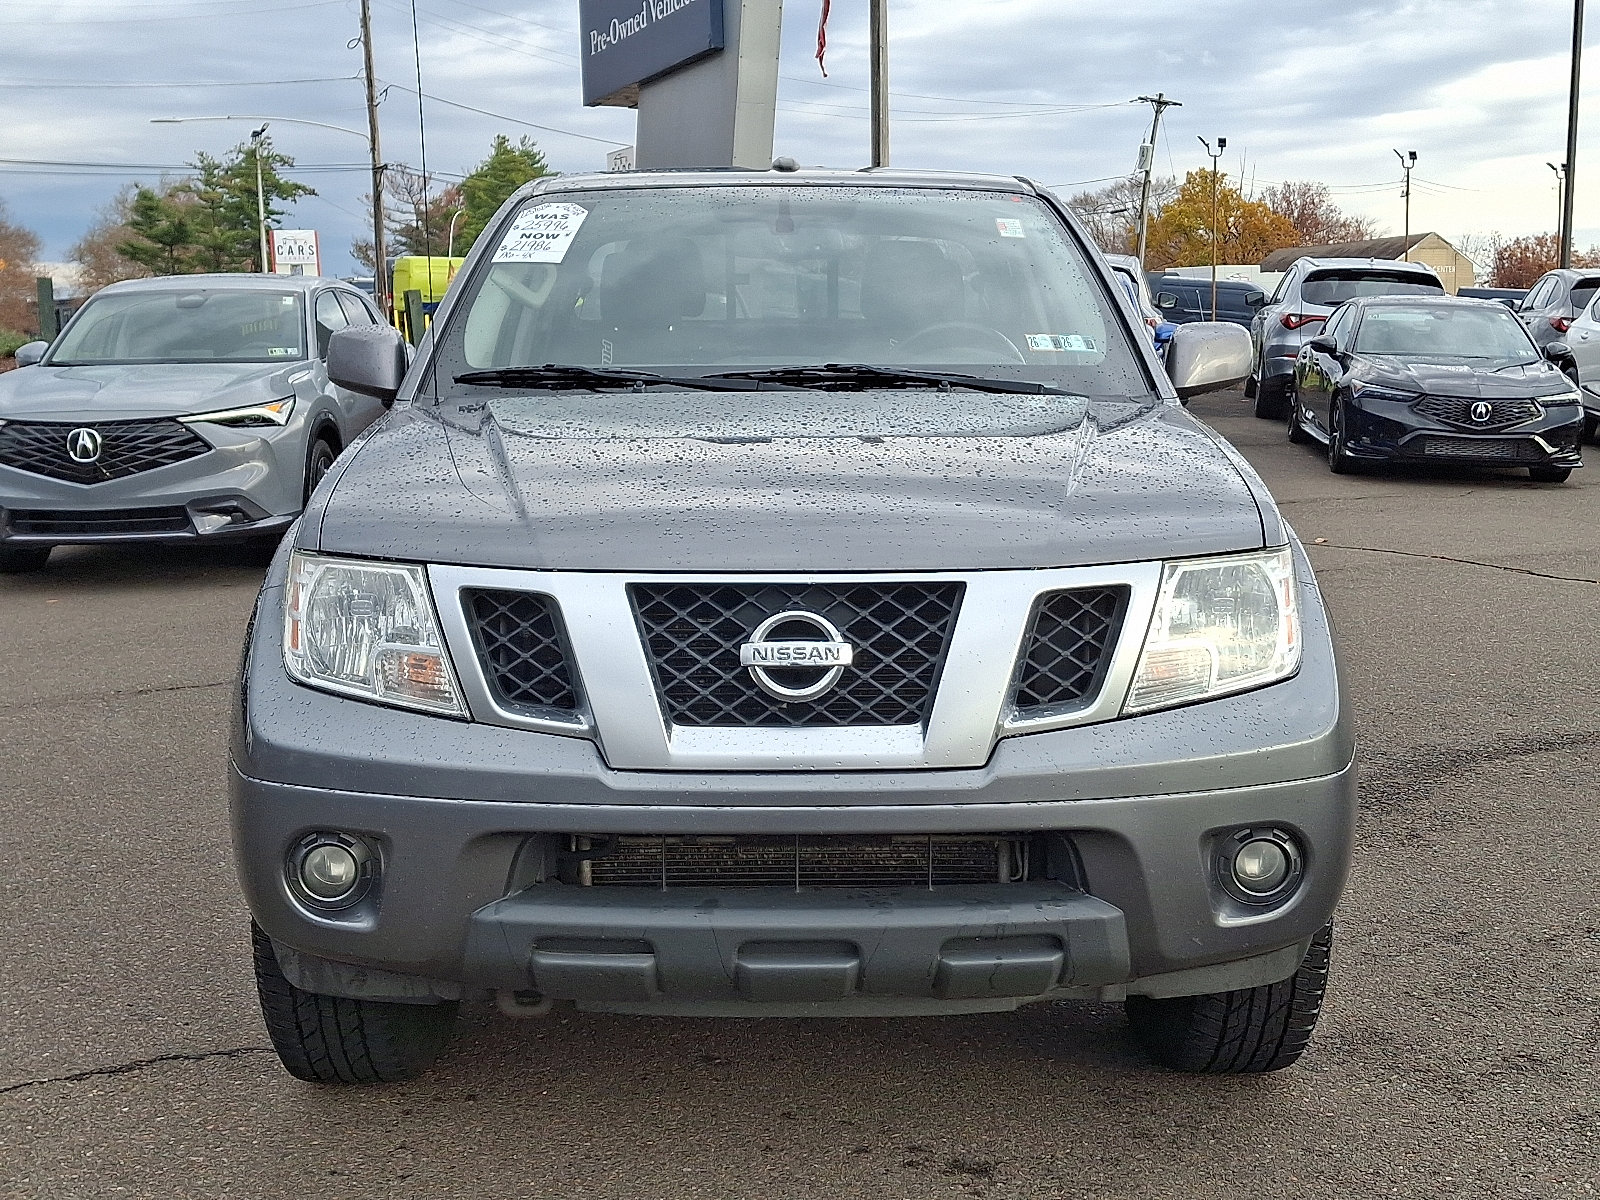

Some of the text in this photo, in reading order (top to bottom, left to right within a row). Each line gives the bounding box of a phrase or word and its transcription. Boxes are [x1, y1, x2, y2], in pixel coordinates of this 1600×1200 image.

[589, 2, 648, 56] Pre-Owned
[519, 232, 561, 240] NOW
[277, 244, 315, 256] CARS
[1432, 265, 1456, 273] CENTER
[752, 646, 841, 661] NISSAN
